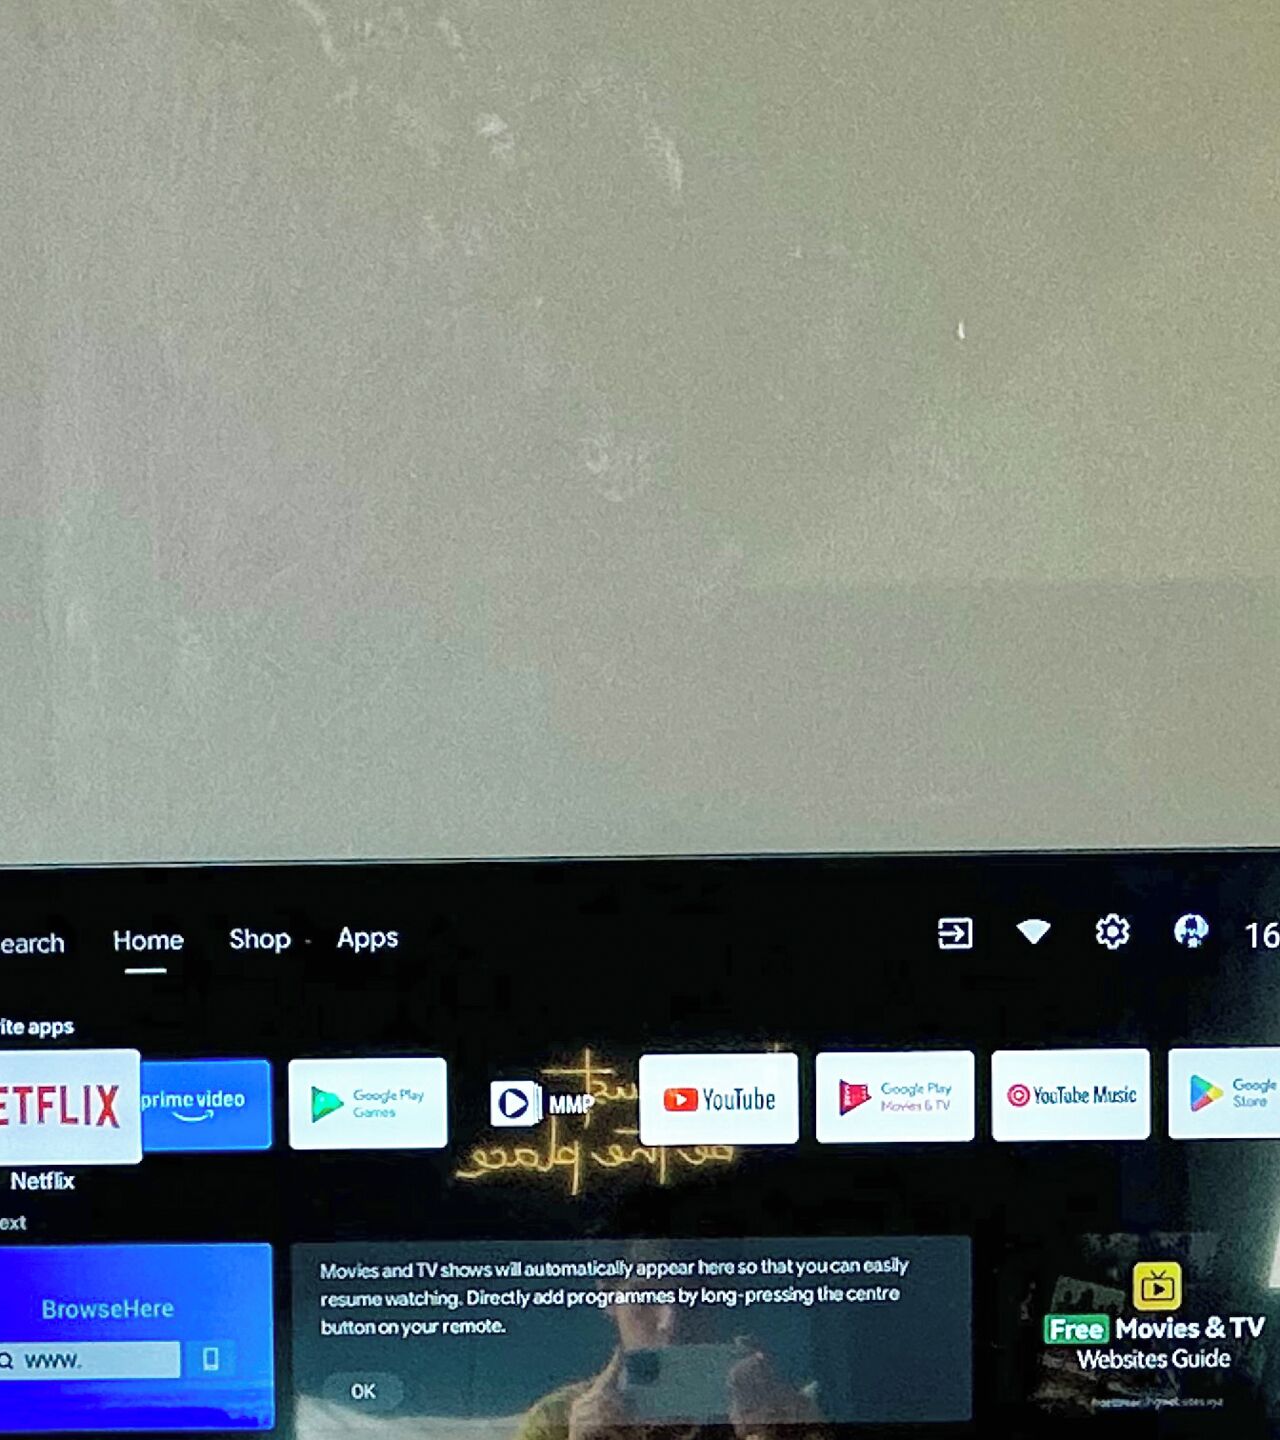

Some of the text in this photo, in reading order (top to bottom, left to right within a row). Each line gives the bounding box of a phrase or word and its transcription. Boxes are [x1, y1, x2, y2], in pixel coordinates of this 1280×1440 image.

[113, 930, 185, 952] Home
[229, 928, 292, 957] Shop
[336, 926, 399, 955] Apps
[27, 1020, 74, 1038] apps
[880, 1082, 952, 1097] Google Play
[1033, 1085, 1138, 1105] YouTube Music
[1232, 1078, 1278, 1093] Google
[140, 1090, 246, 1110] prime video
[353, 1088, 424, 1104] Google Play
[548, 1094, 595, 1115] MMP
[703, 1088, 776, 1112] YouTube
[880, 1100, 922, 1112] Movies
[935, 1100, 951, 1111] TV
[1233, 1095, 1268, 1108] Store
[353, 1107, 396, 1118] Games
[10, 1170, 76, 1191] Netflix
[320, 1256, 910, 1281] Movies and TV shows will automatically appear here so that you can easily
[320, 1285, 901, 1311] resume watching. Directly add programmes by long-pressing the centre
[41, 1299, 175, 1321] BrowseHere
[320, 1319, 507, 1339] button on your remote.
[1049, 1315, 1266, 1341] Free Movies & TV
[1076, 1347, 1232, 1370] Websites Guide
[351, 1383, 377, 1400] OK
